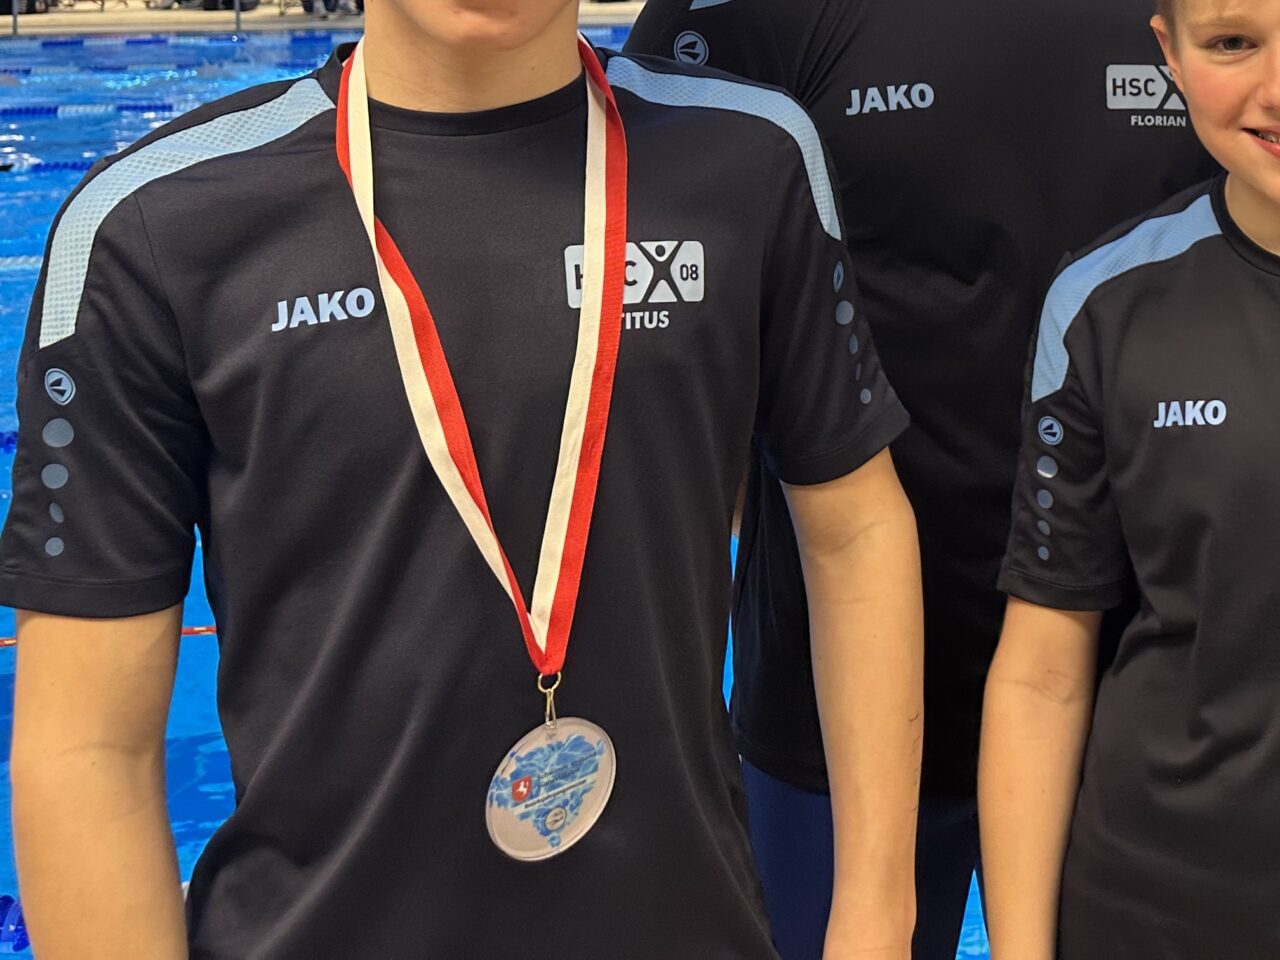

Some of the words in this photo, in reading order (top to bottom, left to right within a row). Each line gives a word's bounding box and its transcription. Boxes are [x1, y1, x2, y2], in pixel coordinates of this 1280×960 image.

[1112, 78, 1156, 97] HSC
[846, 83, 935, 115] JAKO
[1130, 115, 1187, 127] FLORIAN
[680, 264, 699, 281] 08
[271, 287, 376, 332] JAKO
[622, 310, 670, 330] ITUS
[1153, 399, 1227, 428] JAKO
